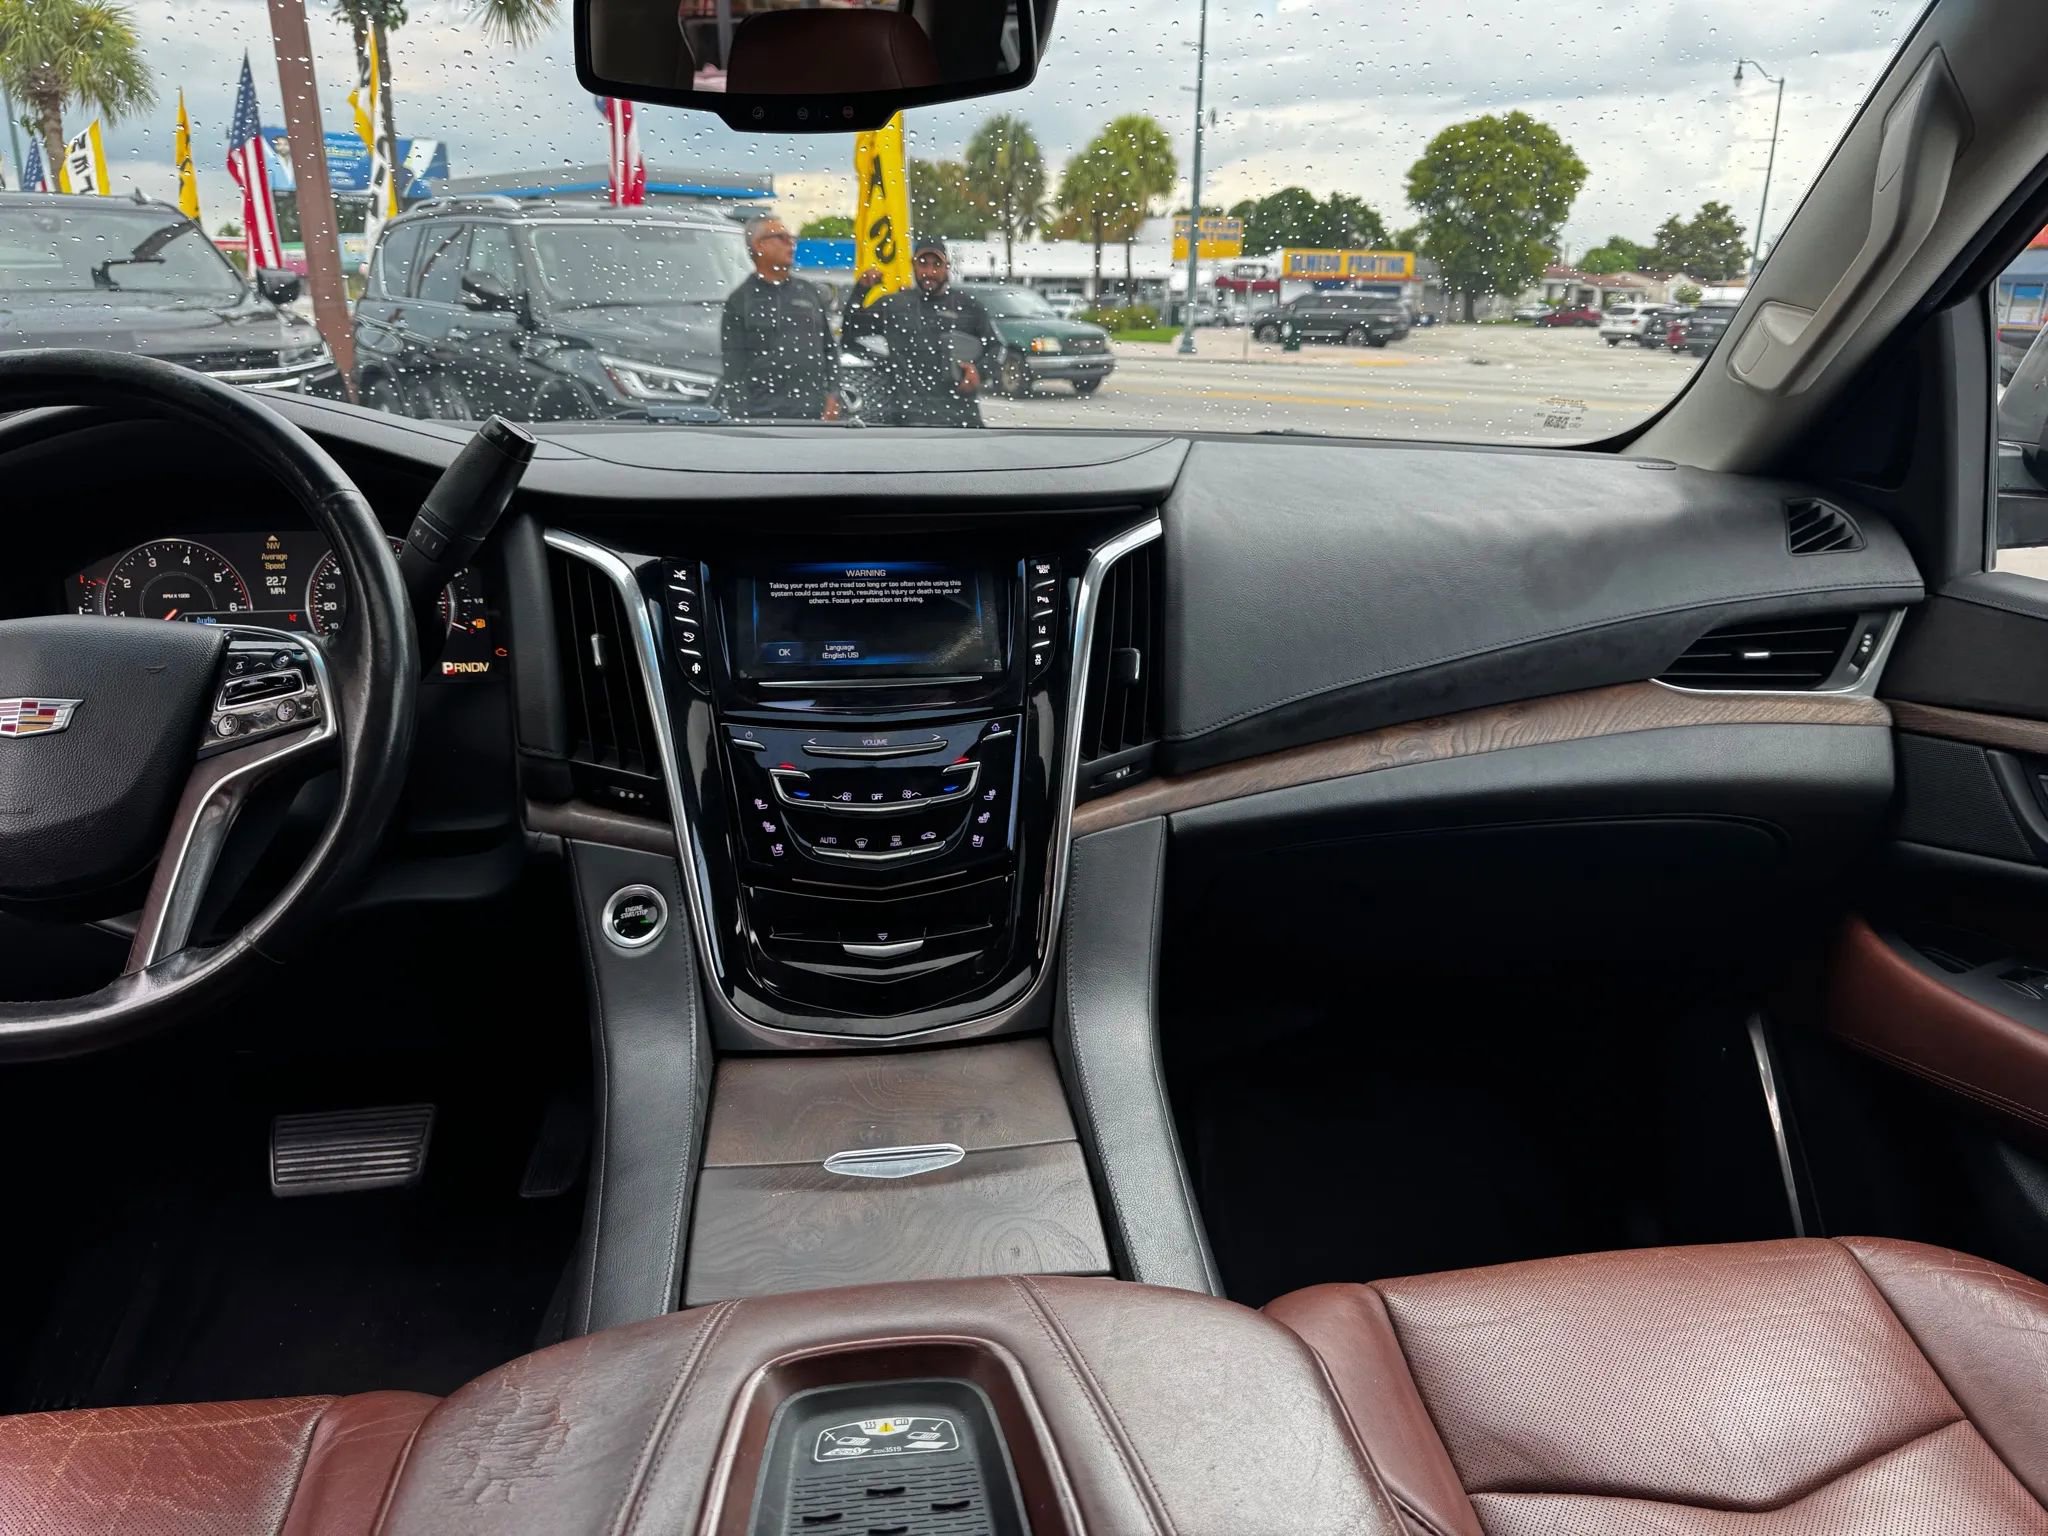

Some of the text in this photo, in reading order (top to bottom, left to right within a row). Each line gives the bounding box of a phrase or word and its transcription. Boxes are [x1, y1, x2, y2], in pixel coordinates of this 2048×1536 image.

[266, 542, 280, 550] NW
[182, 555, 191, 566] 4
[261, 553, 288, 561] Average
[148, 557, 157, 568] 3
[264, 562, 286, 570] Speed
[845, 569, 887, 577] WARNING
[213, 572, 223, 583] 5
[266, 576, 288, 586] 22.7
[123, 578, 132, 589] 2
[769, 582, 789, 590] Taking
[933, 580, 949, 588] using
[270, 587, 286, 595] MPH
[770, 590, 793, 598] system
[903, 596, 924, 604] driving.
[229, 602, 238, 613] 6
[323, 602, 337, 611] 20
[196, 616, 217, 624] Audio
[330, 622, 339, 630] 10
[778, 648, 791, 657] OK
[822, 651, 859, 660] (English US)
[862, 738, 888, 746] VOLUME
[871, 793, 883, 801] OFF
